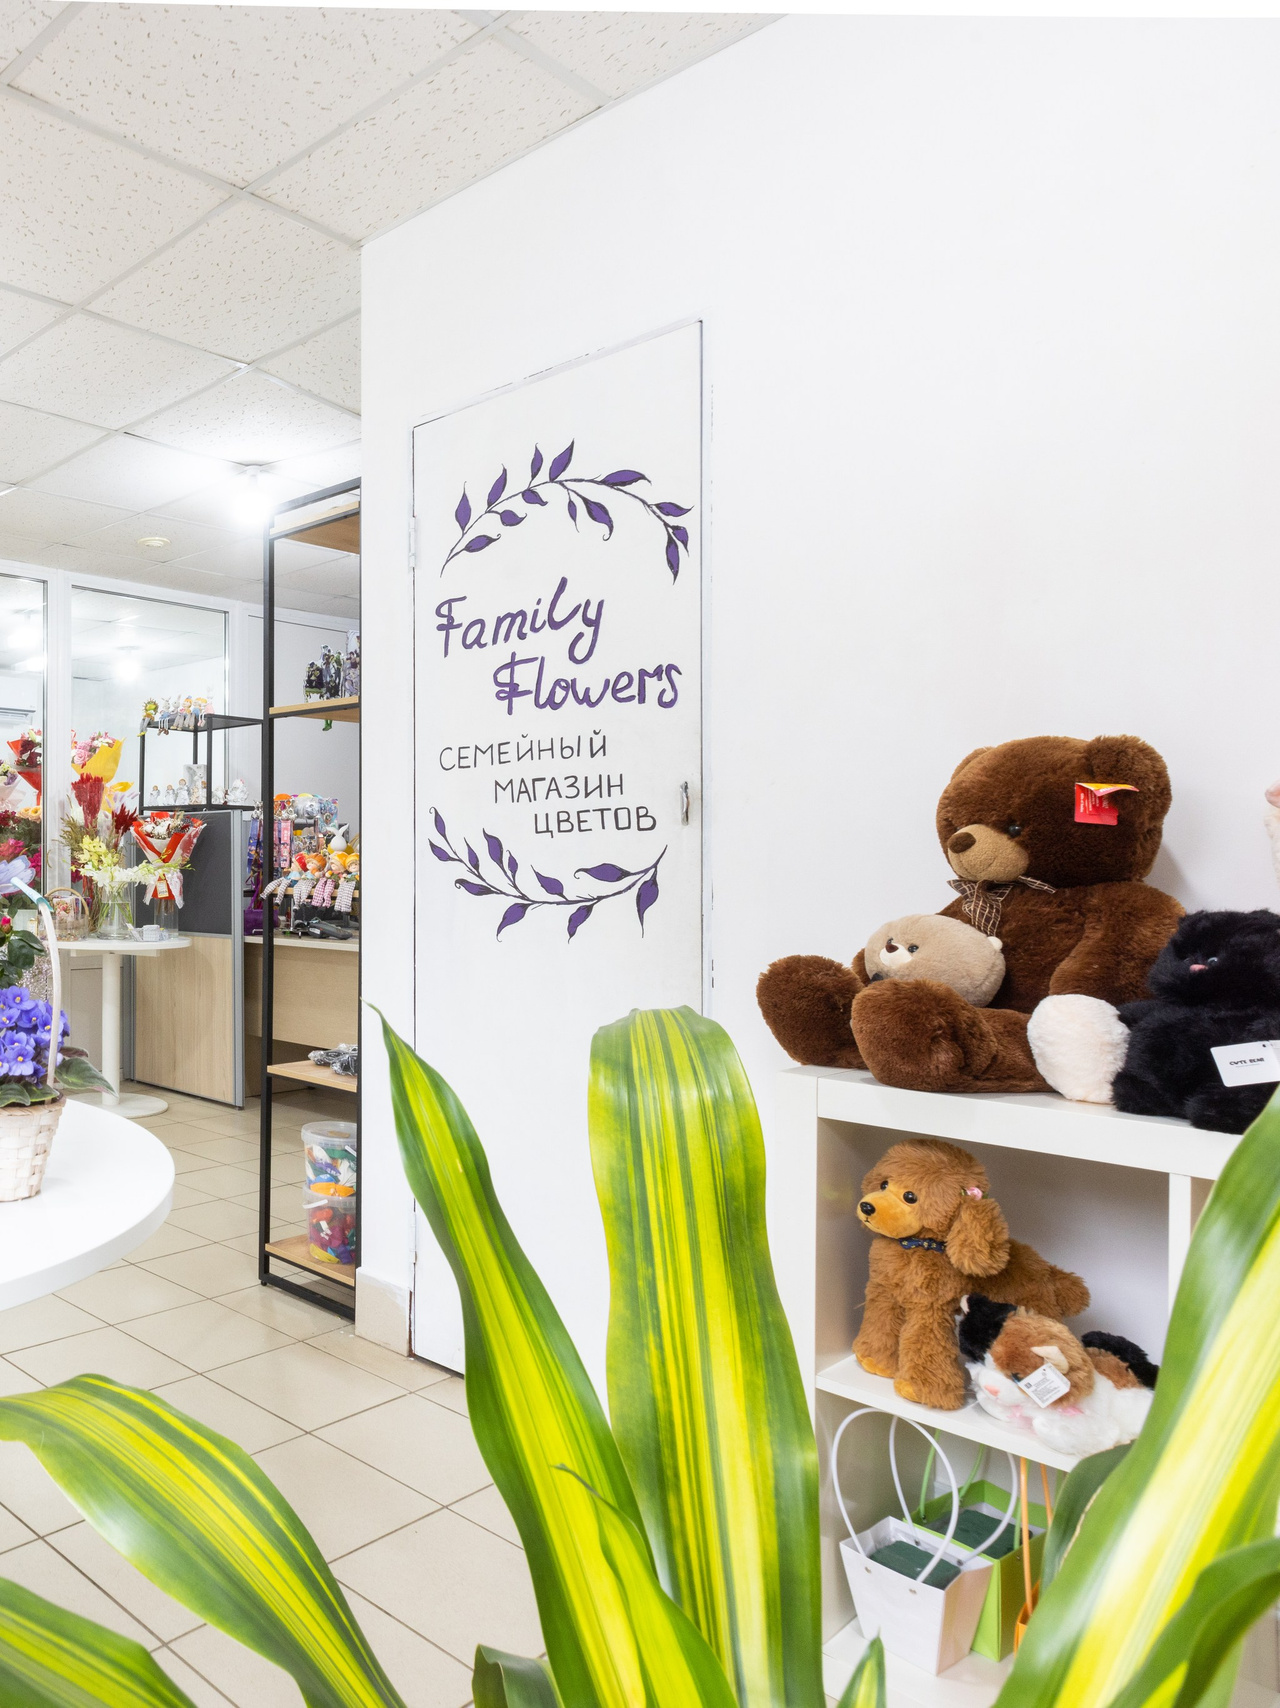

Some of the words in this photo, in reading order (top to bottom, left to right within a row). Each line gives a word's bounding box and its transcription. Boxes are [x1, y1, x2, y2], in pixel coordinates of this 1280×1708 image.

[434, 576, 605, 665] Family
[492, 651, 683, 716] Flowers
[439, 729, 607, 771] СЕМЕЙНЫЙ
[494, 773, 624, 804] МАГАЗИН
[533, 805, 658, 839] ЦВЕТОВ
